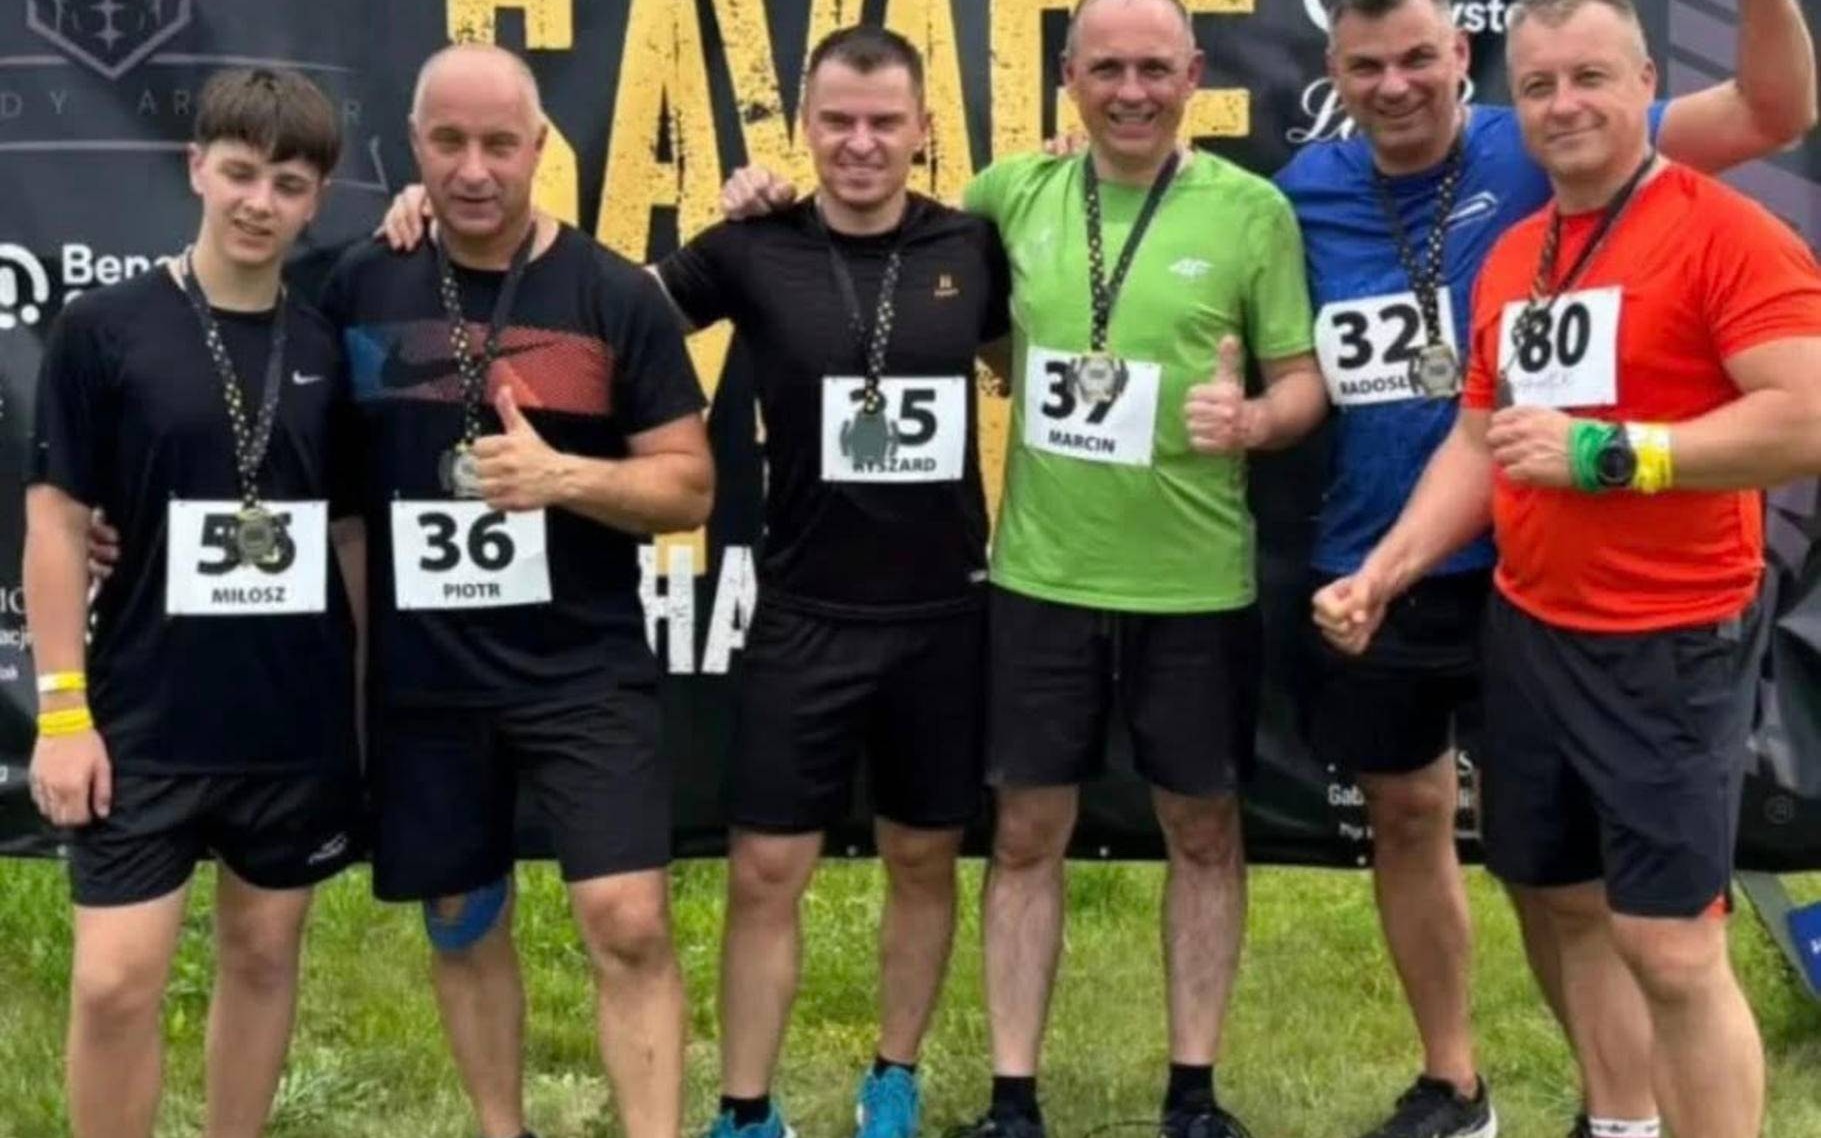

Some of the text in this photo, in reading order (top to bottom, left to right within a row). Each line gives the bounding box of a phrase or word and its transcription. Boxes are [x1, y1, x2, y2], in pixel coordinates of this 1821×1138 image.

[1331, 303, 1421, 370] 32
[1517, 302, 1591, 374] 80
[1048, 430, 1116, 453] MARCIN
[417, 511, 516, 572] 36
[443, 583, 501, 599] PIOTR
